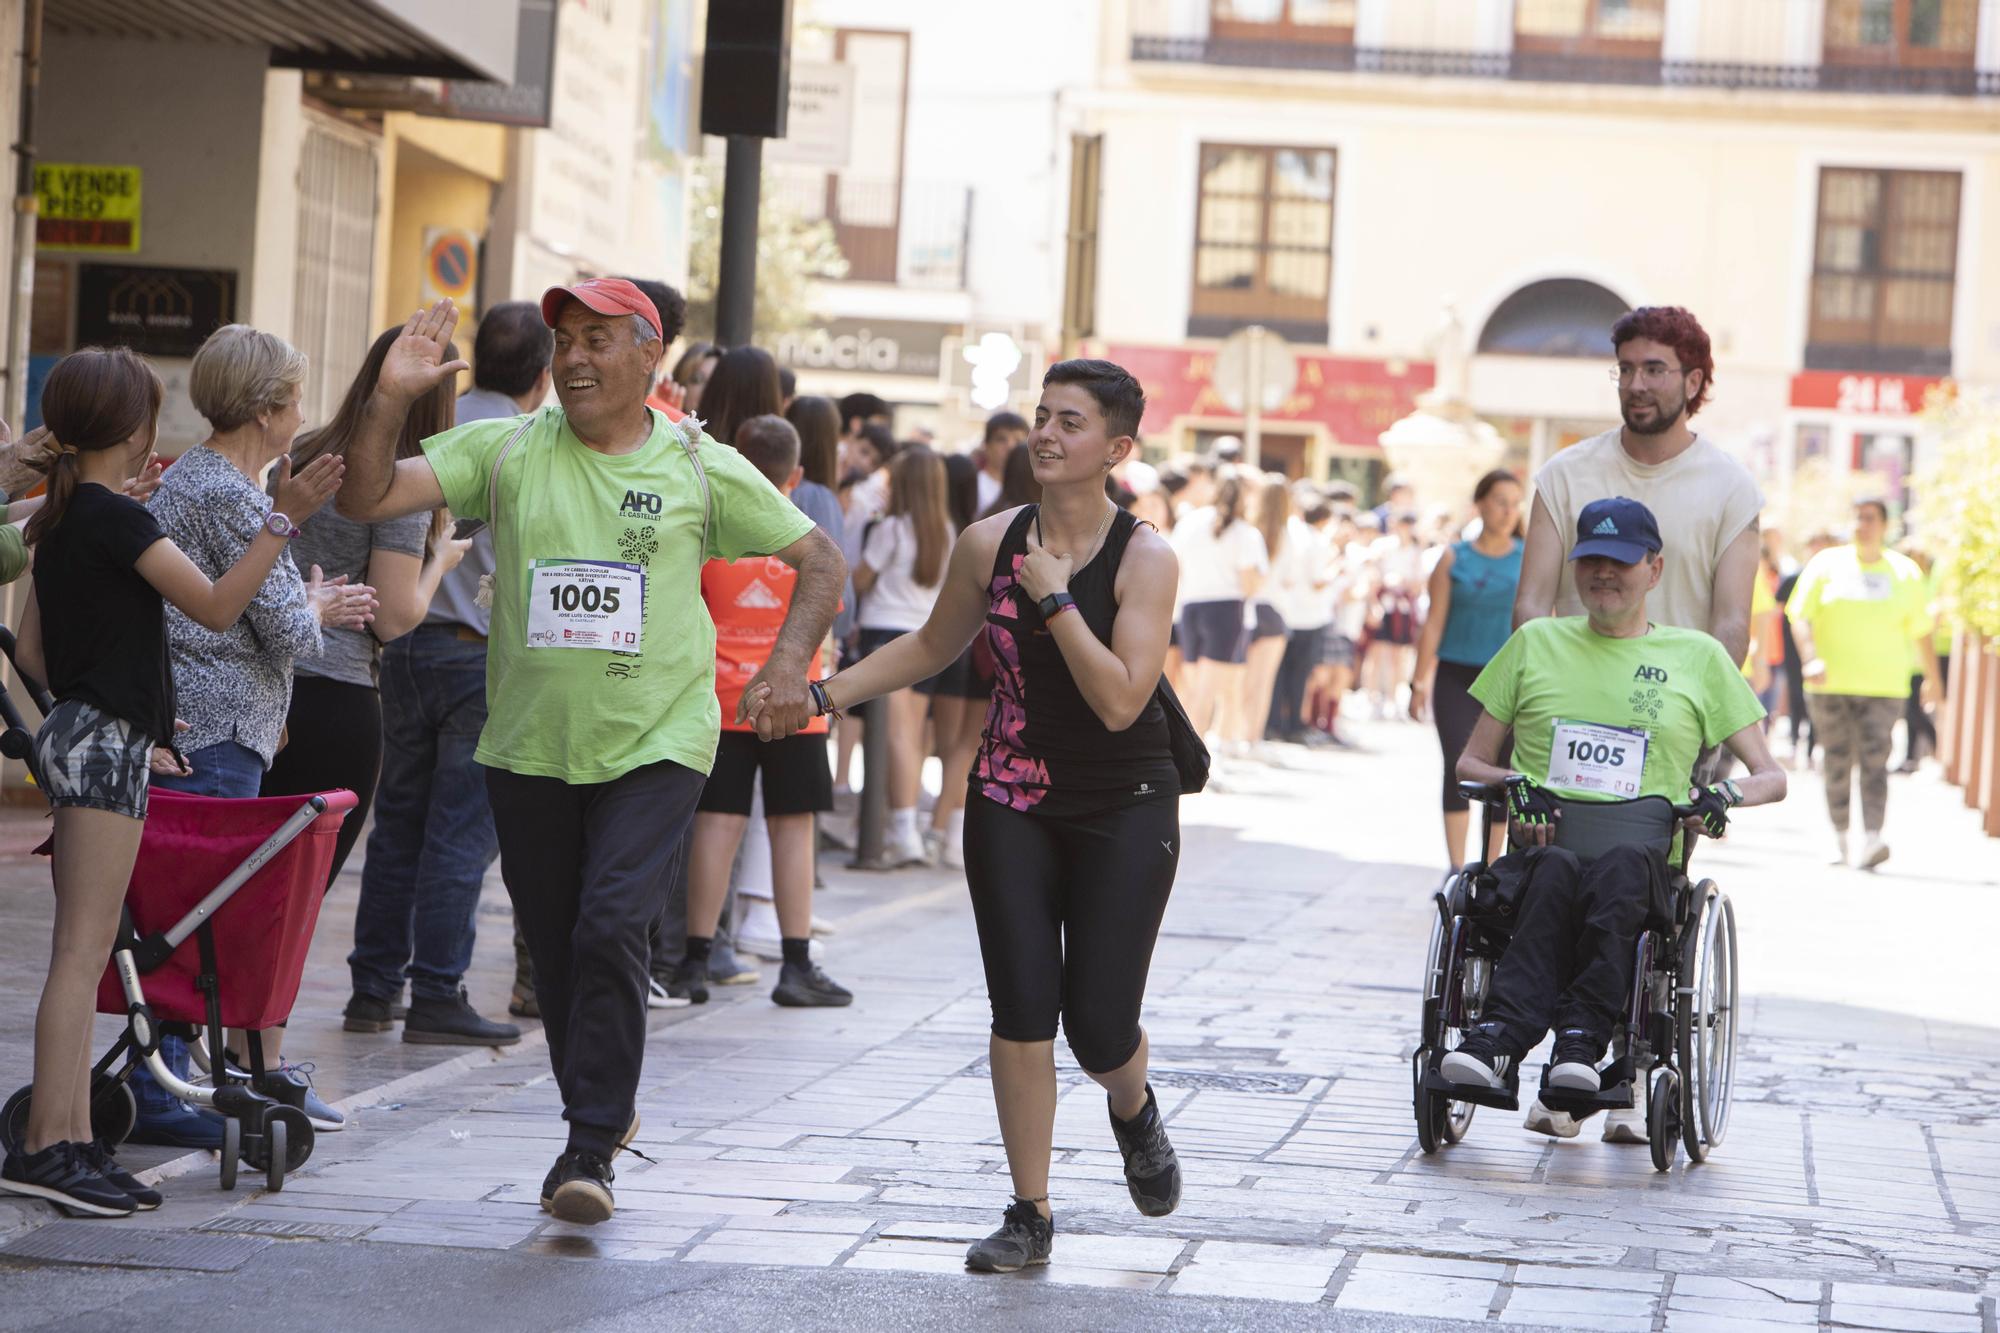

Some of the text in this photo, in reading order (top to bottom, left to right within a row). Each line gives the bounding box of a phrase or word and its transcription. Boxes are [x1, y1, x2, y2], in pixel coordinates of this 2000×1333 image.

[60, 172, 131, 197] VENDE
[46, 196, 105, 217] PISO
[1838, 375, 1876, 413] 24
[619, 489, 663, 515] APO
[627, 511, 662, 521] CASTELLET
[550, 584, 620, 613] 1005
[606, 662, 631, 680] 30
[1634, 664, 1668, 684] APO
[1568, 740, 1625, 766] 1005
